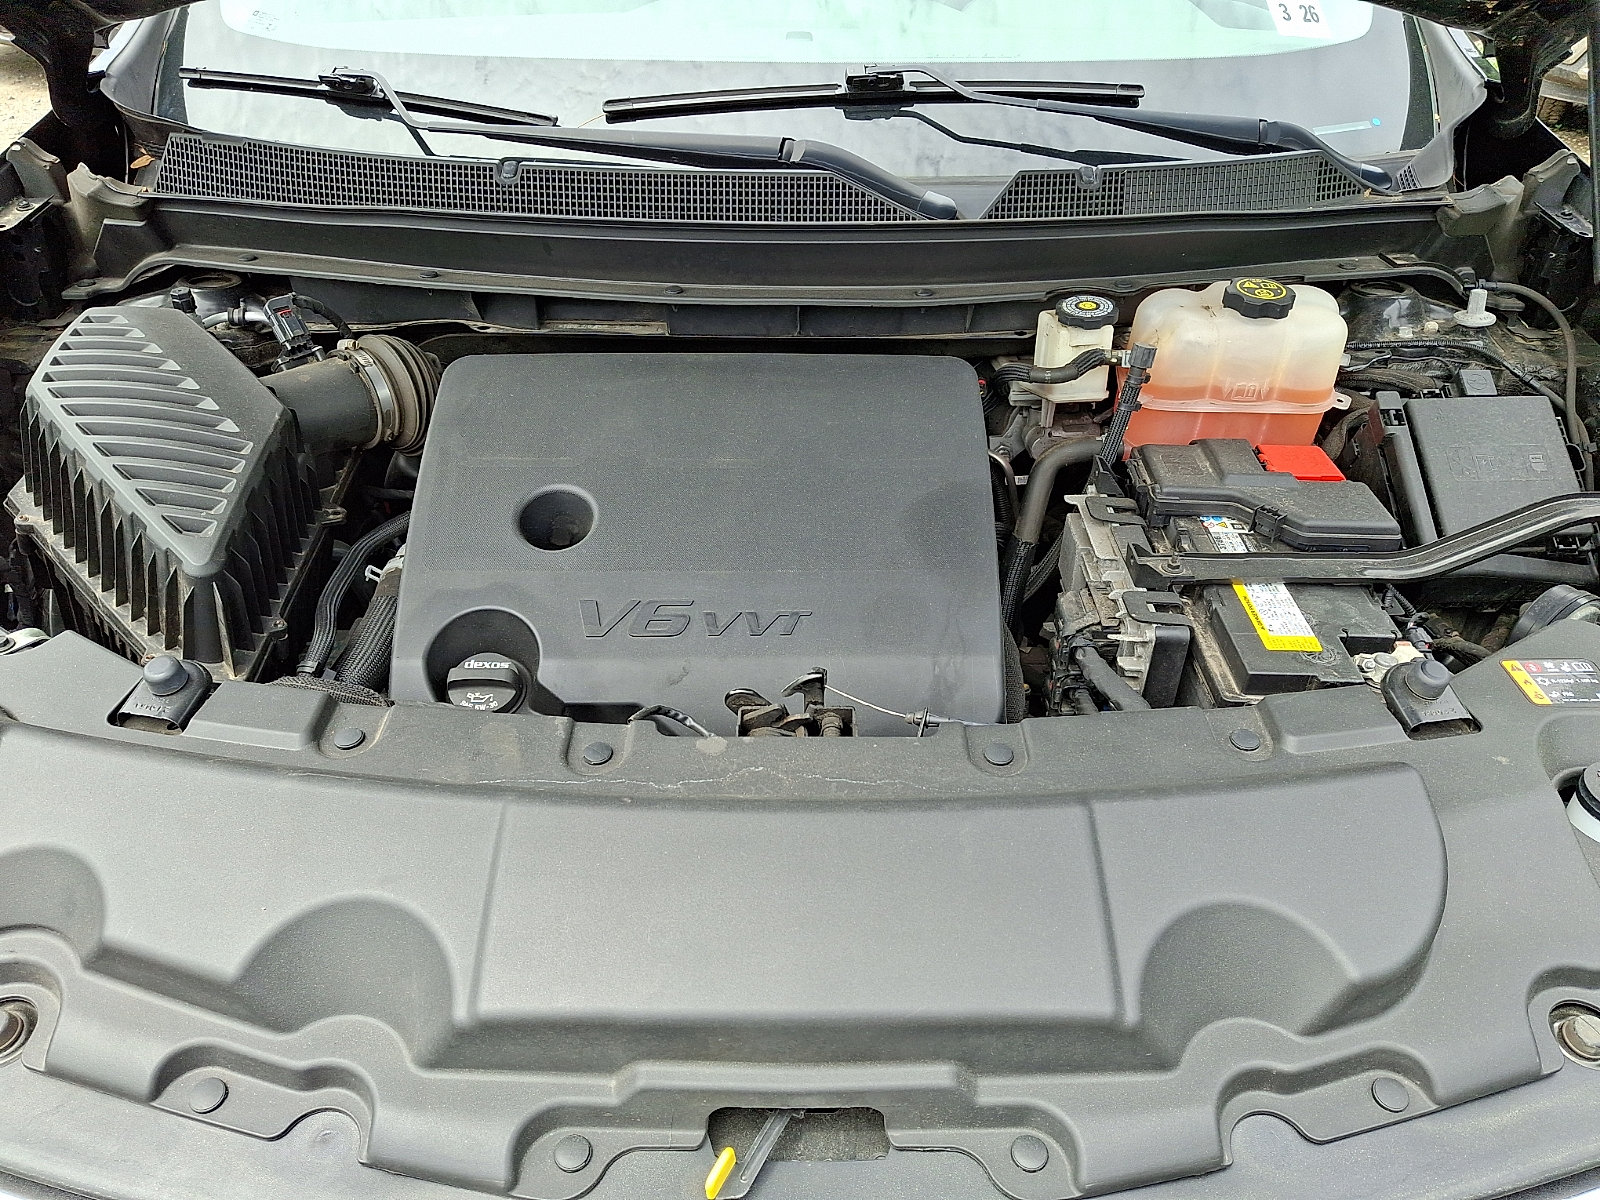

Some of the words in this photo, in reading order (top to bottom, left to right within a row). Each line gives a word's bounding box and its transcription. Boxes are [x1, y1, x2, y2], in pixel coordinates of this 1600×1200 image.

[1278, 3, 1292, 21] 3
[1299, 4, 1320, 24] 26
[579, 600, 695, 638] V6
[702, 610, 813, 637] VVT
[463, 659, 512, 670] dexos
